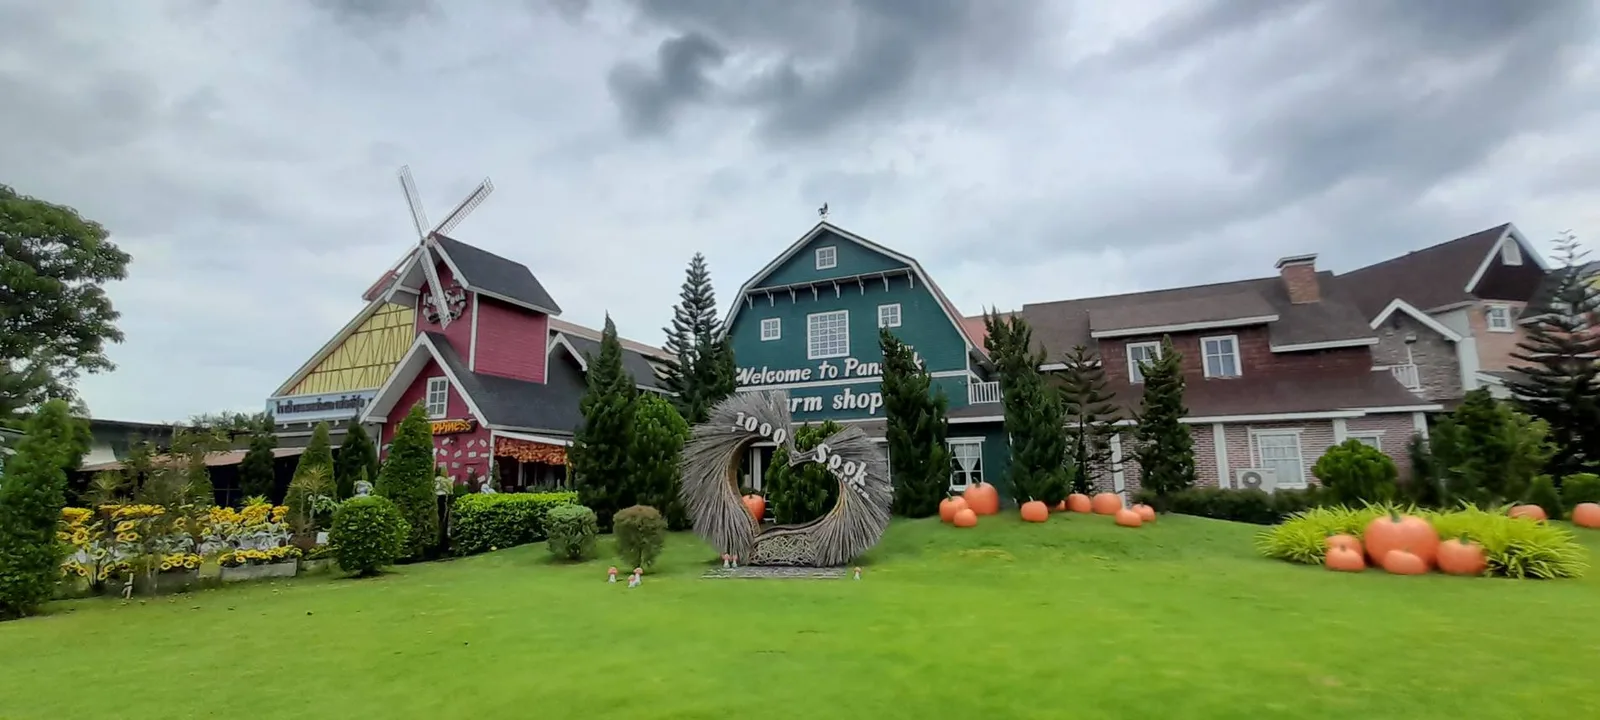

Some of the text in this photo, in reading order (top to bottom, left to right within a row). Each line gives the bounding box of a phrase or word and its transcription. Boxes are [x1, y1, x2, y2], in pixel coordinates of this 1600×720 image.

[735, 365, 812, 385] Welcome
[819, 360, 838, 379] to
[832, 387, 883, 414] shop
[735, 412, 868, 486] 1000 Sook
